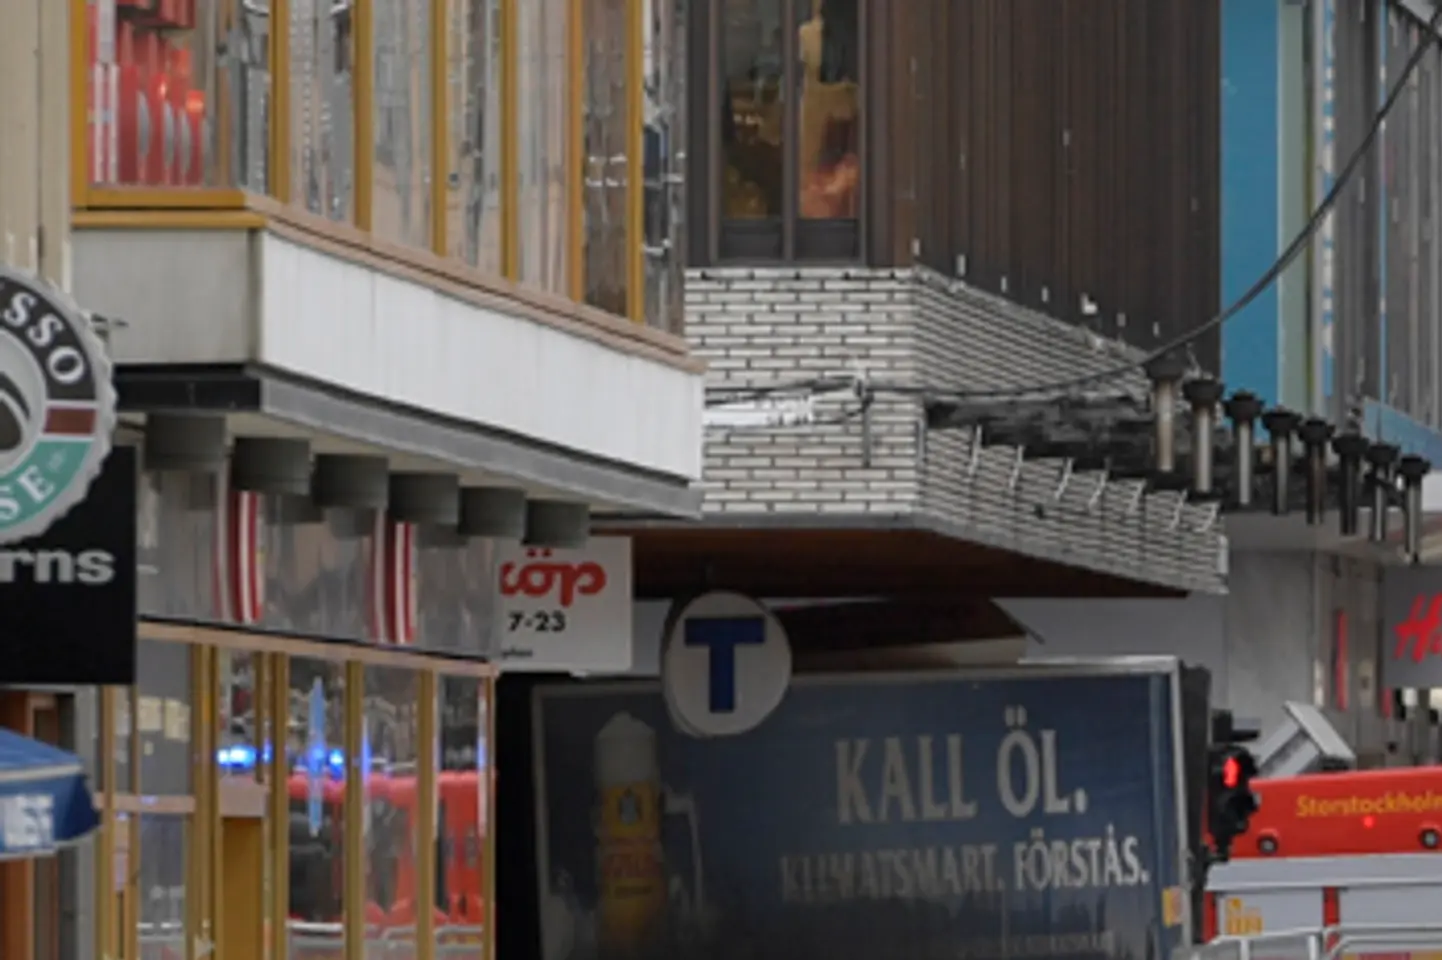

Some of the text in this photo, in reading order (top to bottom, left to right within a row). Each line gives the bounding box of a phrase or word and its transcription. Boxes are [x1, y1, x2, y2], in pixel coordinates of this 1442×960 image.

[0, 284, 85, 385] SSO
[509, 610, 567, 633] 7-23
[683, 614, 767, 714] T
[834, 704, 1089, 826] KALL ÖL.
[1014, 822, 1150, 892] FÖRSTÅS.
